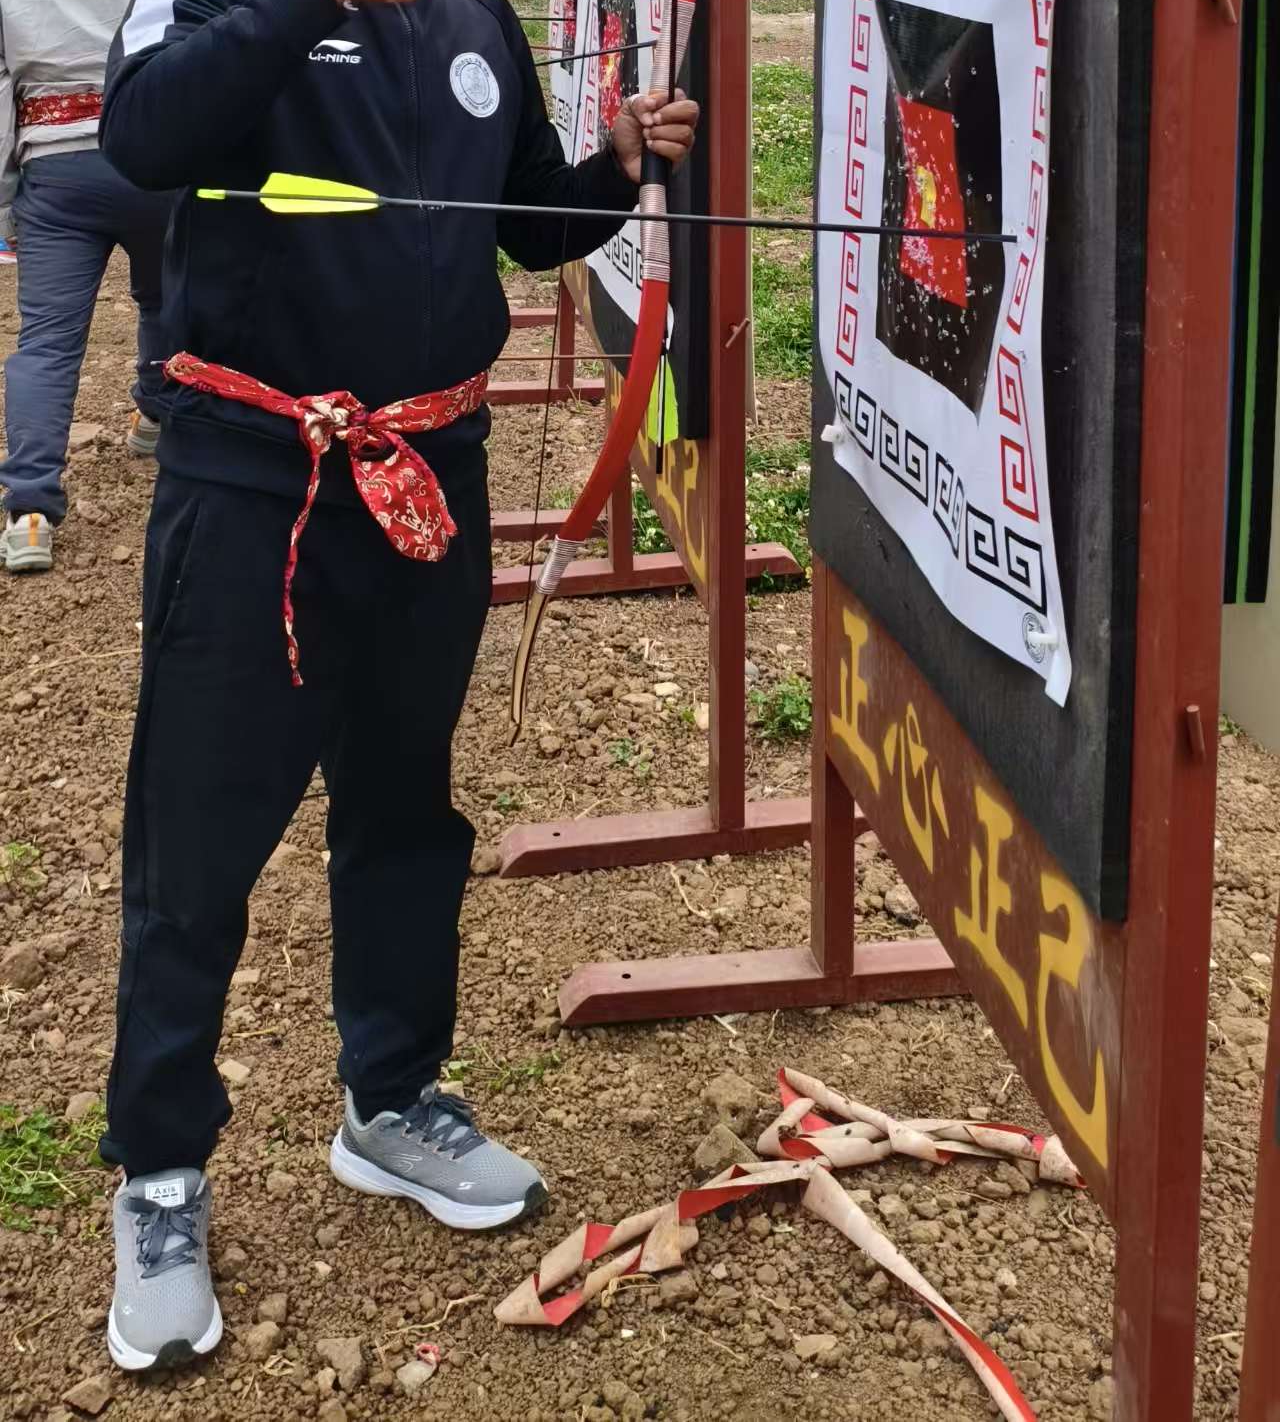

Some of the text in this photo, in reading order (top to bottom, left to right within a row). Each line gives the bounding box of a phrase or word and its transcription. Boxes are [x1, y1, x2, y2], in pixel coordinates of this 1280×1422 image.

[308, 51, 362, 64] LI-NING
[830, 606, 1108, 1169] 正心正己
